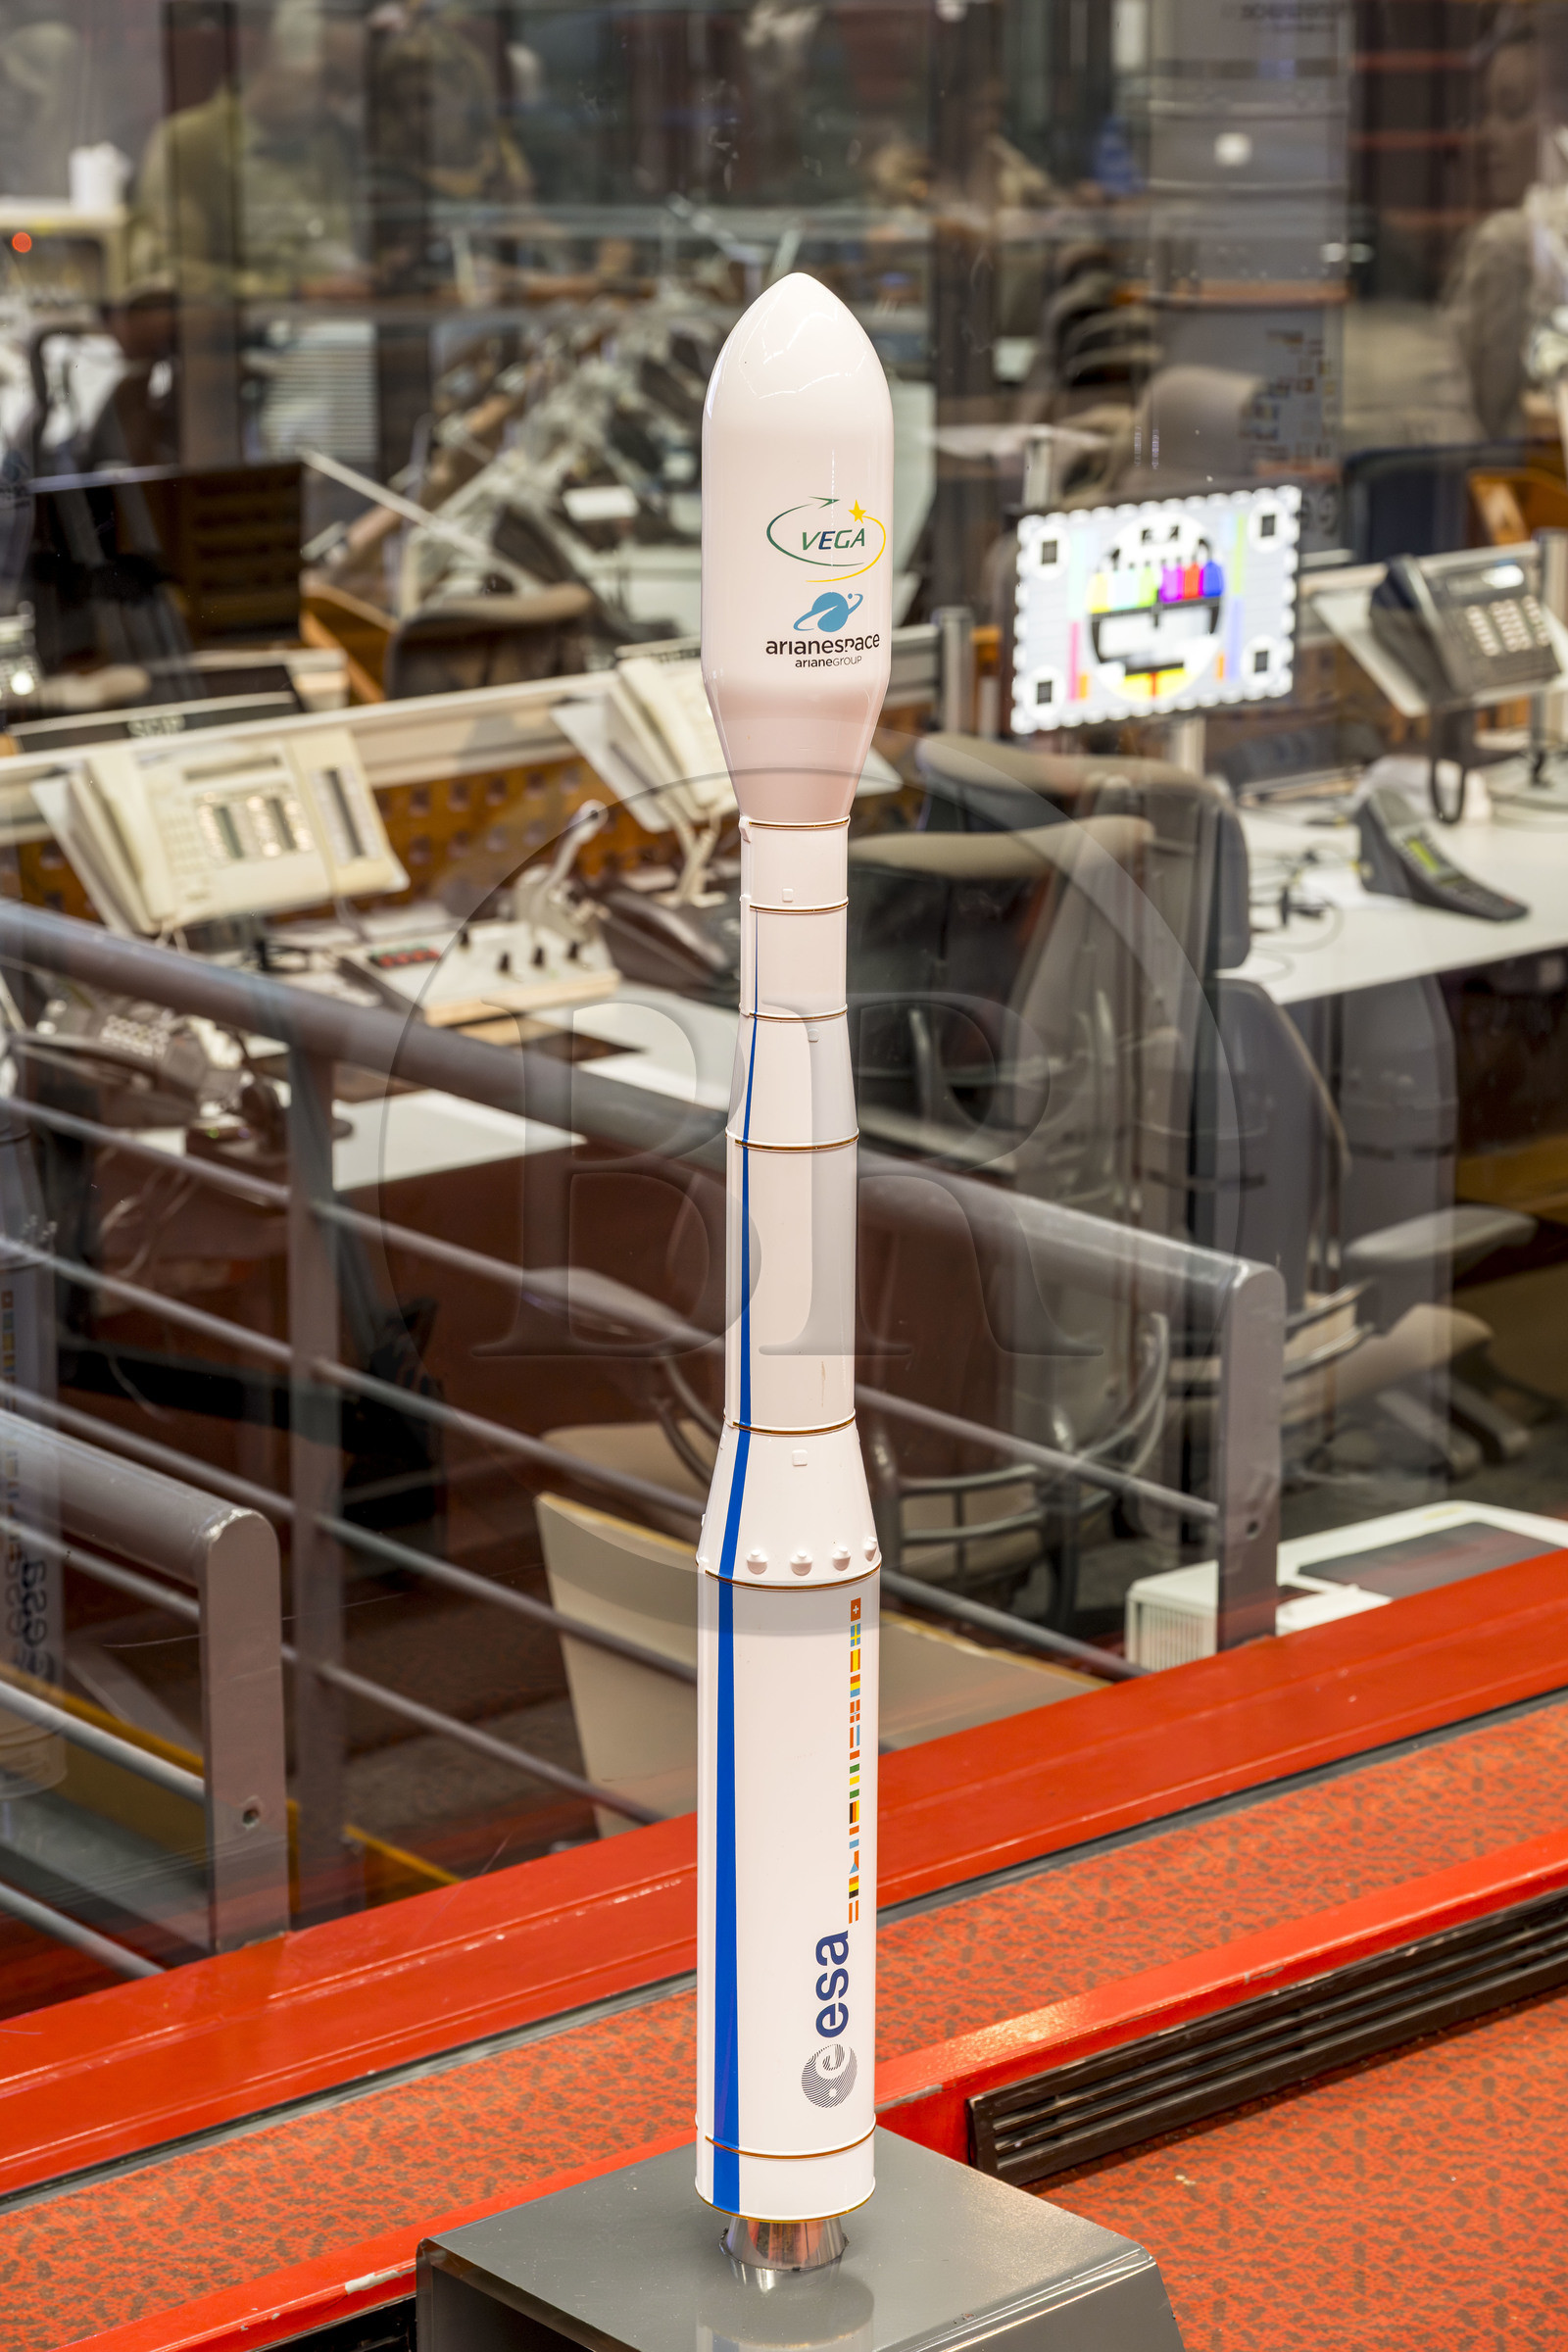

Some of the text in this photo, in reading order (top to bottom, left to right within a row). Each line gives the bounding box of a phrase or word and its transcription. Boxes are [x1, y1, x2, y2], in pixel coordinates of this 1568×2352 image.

[802, 527, 865, 551] VEGA
[765, 633, 881, 655] arianespace
[815, 1930, 850, 2038] esa
